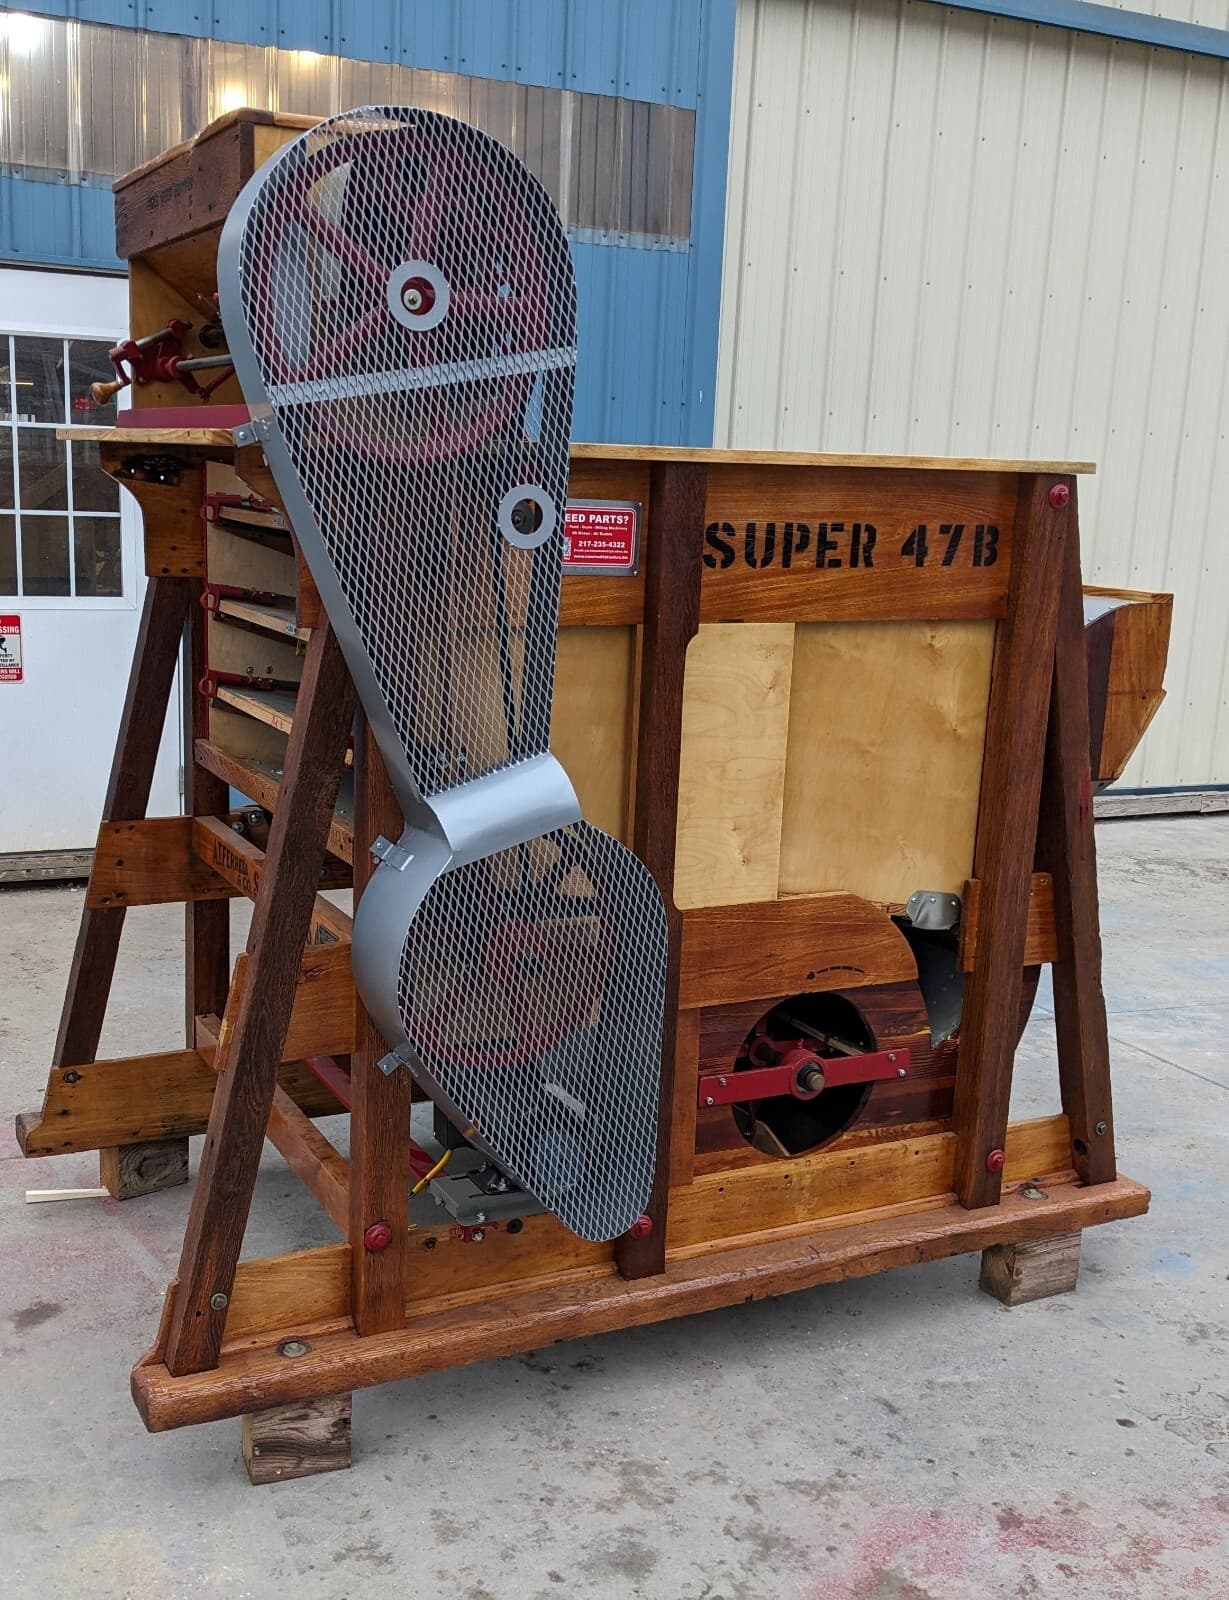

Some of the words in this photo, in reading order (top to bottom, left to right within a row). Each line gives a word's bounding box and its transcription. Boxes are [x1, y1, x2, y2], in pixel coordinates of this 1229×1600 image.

[565, 513, 586, 523] EED
[589, 514, 629, 525] PARTS?
[578, 540, 625, 548] 217-235-4322
[702, 522, 877, 569] SUPER
[901, 524, 999, 567] 47B
[0, 625, 20, 634] SSING
